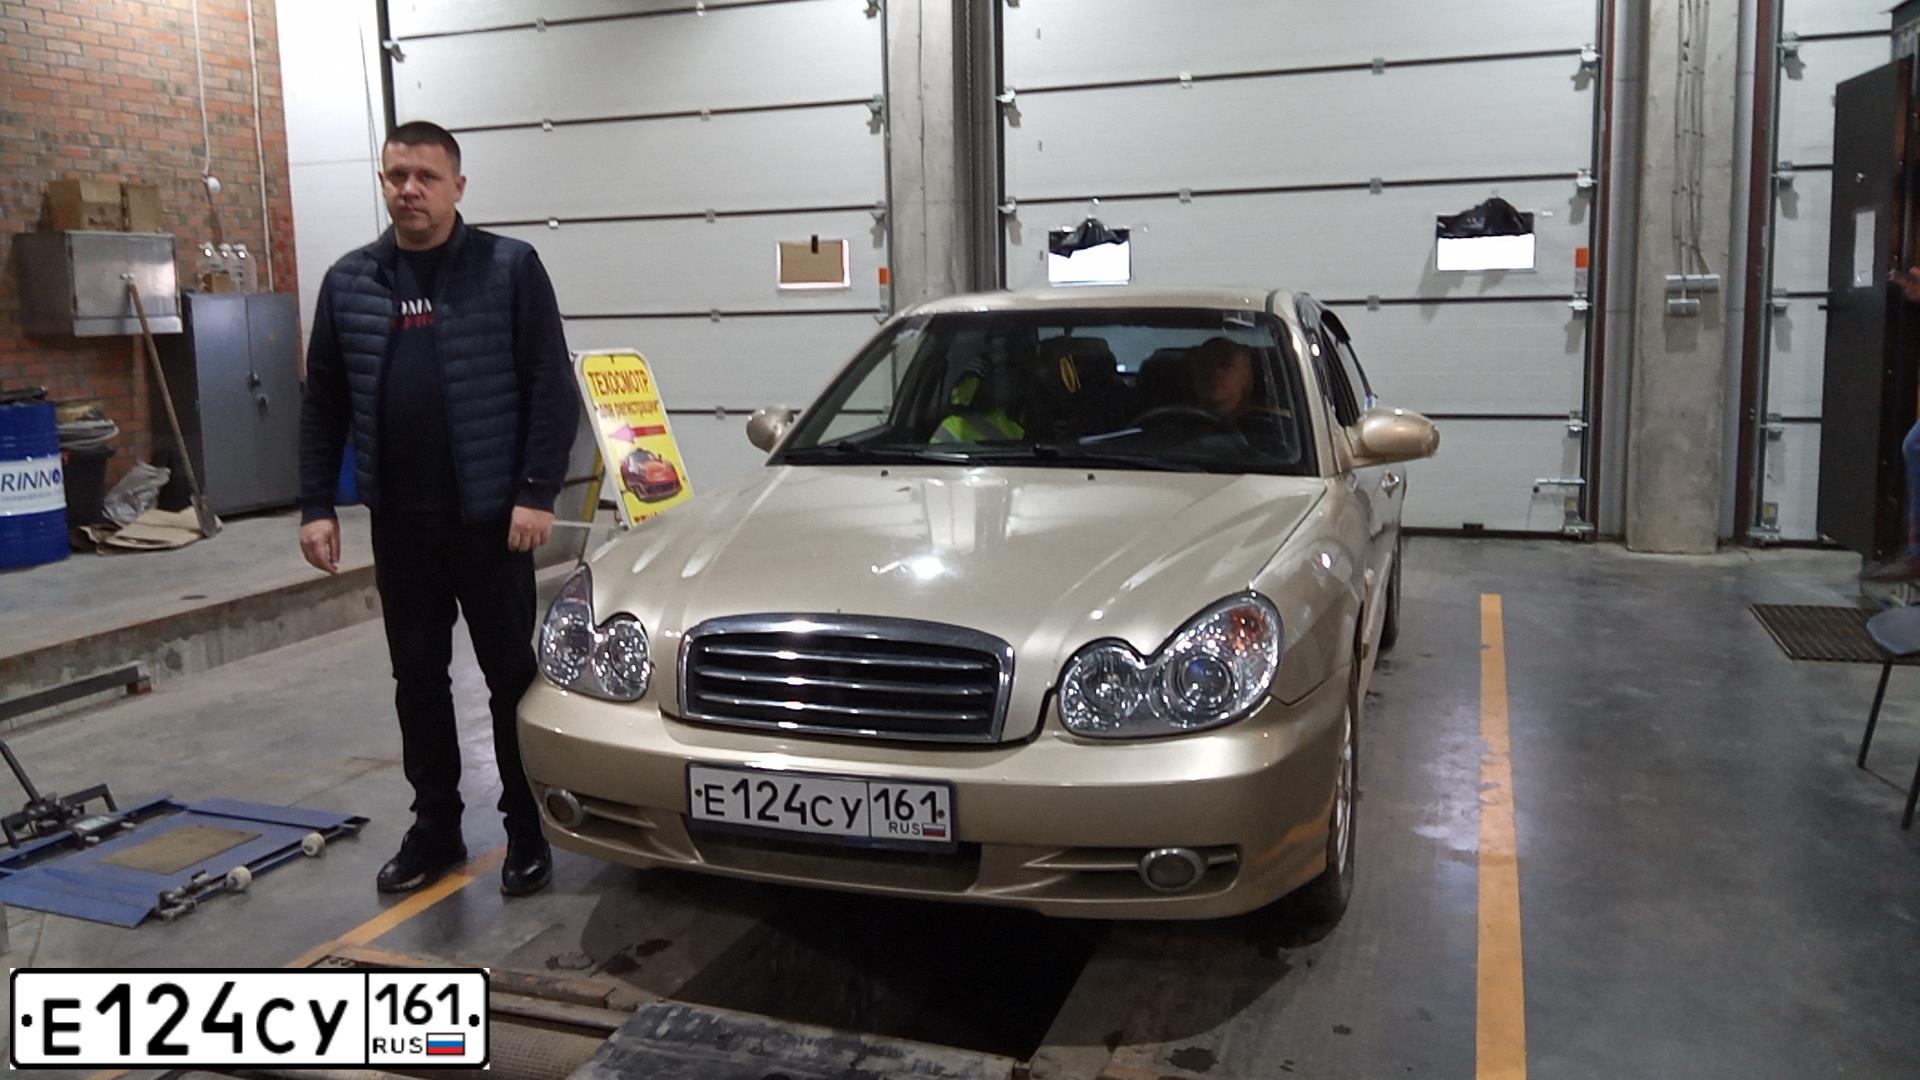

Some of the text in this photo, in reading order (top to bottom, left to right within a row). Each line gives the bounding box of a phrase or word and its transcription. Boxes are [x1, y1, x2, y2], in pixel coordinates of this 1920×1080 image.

[587, 368, 650, 397] ТЕХОСМОТР
[872, 787, 939, 824] 161
[888, 820, 922, 837] RUS
